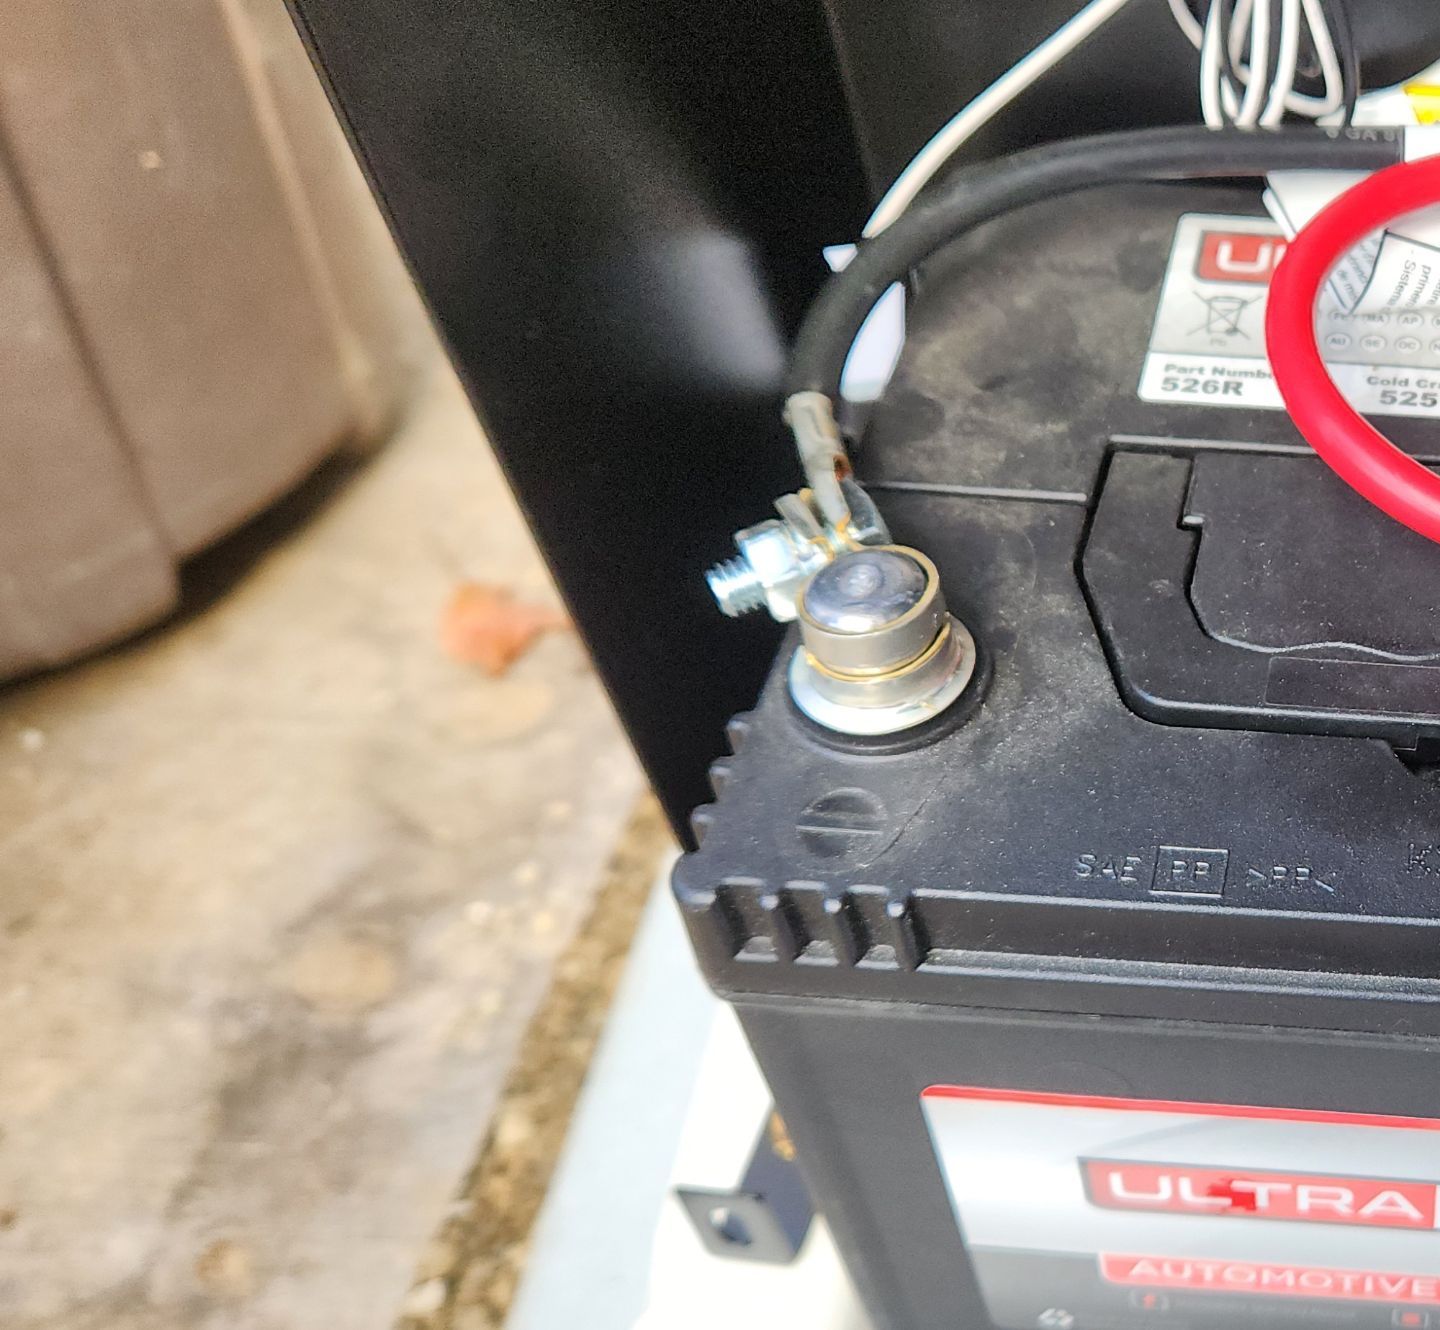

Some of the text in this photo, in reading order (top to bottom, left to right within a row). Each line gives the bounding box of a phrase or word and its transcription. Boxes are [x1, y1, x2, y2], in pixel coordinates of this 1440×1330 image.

[1163, 362, 1206, 376] Part
[1161, 376, 1245, 397] 526R
[1366, 375, 1410, 388] Cold
[1379, 388, 1439, 408] 525
[1128, 1257, 1438, 1299] AUTOMOTIVE
